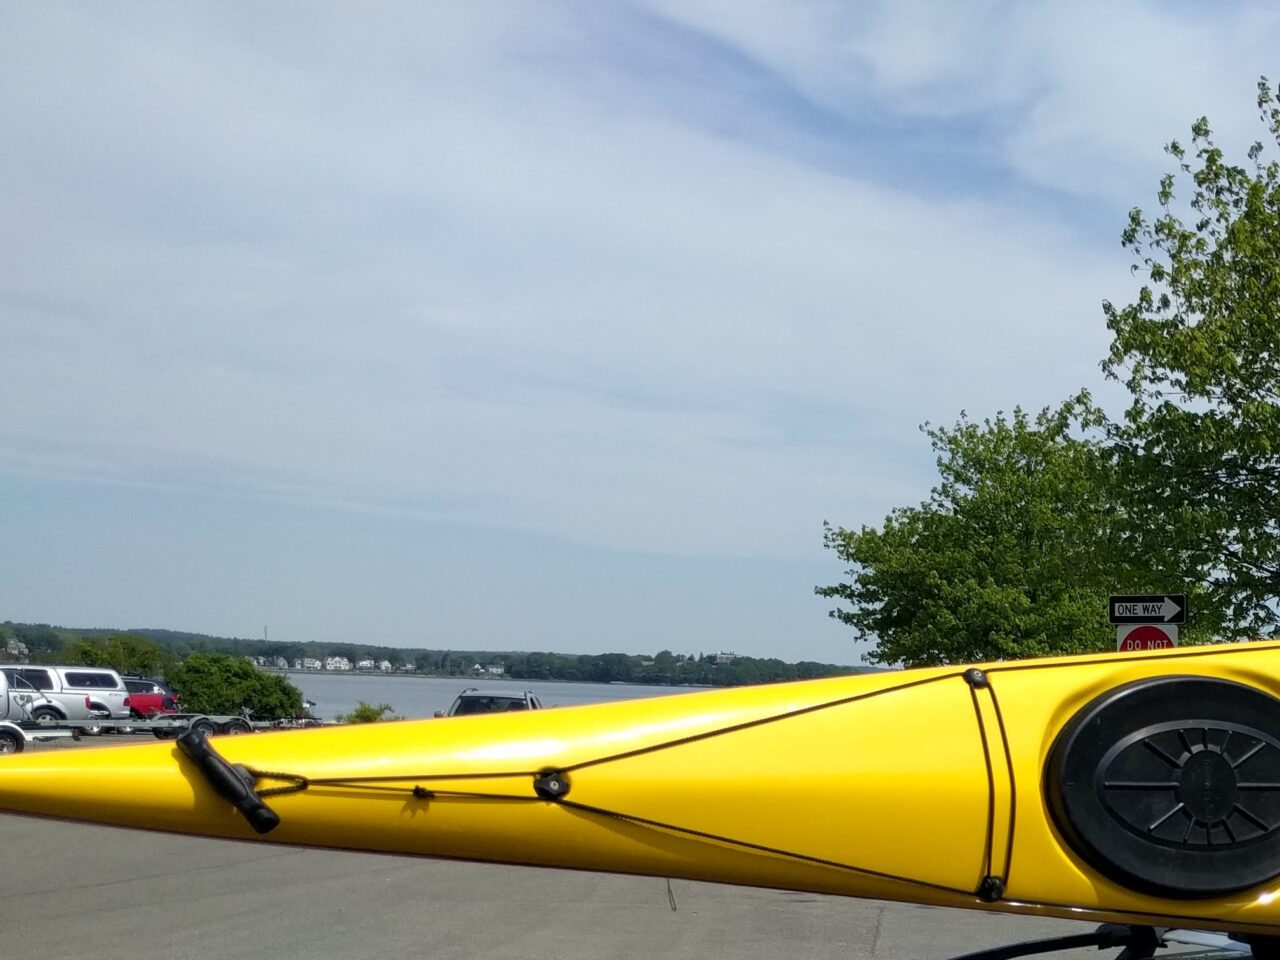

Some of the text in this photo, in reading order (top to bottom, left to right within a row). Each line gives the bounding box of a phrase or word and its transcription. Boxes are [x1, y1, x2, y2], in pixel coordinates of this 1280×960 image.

[1117, 604, 1163, 615] ONE WAY
[1127, 640, 1168, 650] DO NOT
